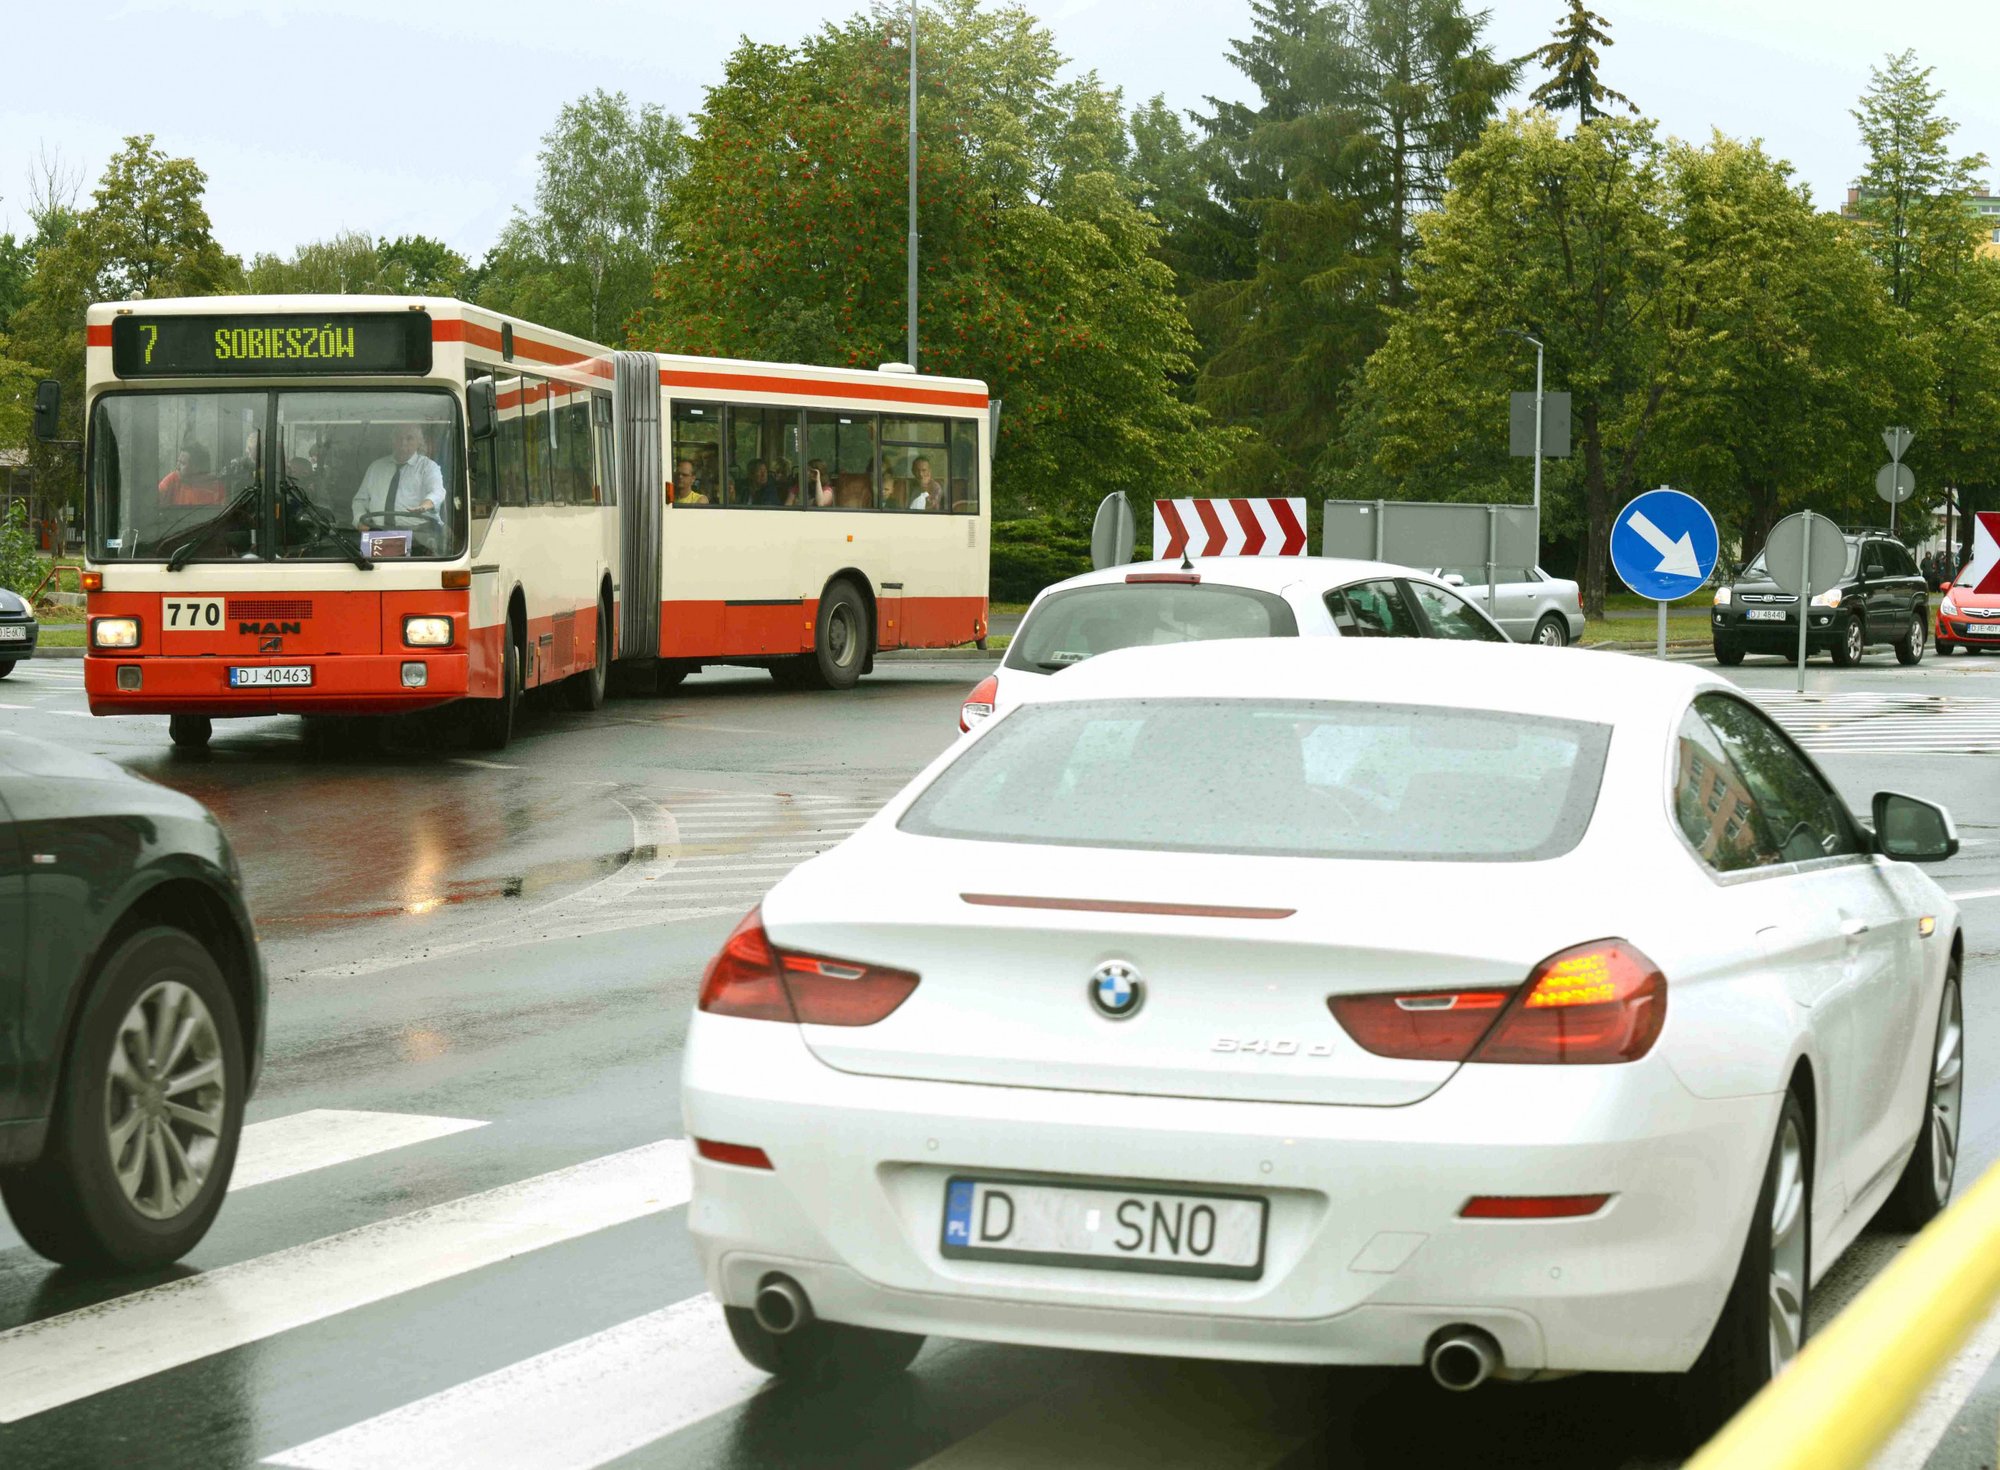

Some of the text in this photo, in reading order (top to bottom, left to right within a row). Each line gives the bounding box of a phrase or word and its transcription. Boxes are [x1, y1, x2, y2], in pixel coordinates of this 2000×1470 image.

[139, 323, 355, 365] 7 SOBIESZÓW
[167, 603, 220, 626] 770
[239, 622, 301, 634] MAN
[240, 668, 308, 683] DJ 40463
[1209, 1034, 1300, 1056] 640
[979, 1190, 1015, 1243] D
[948, 1220, 968, 1237] PL
